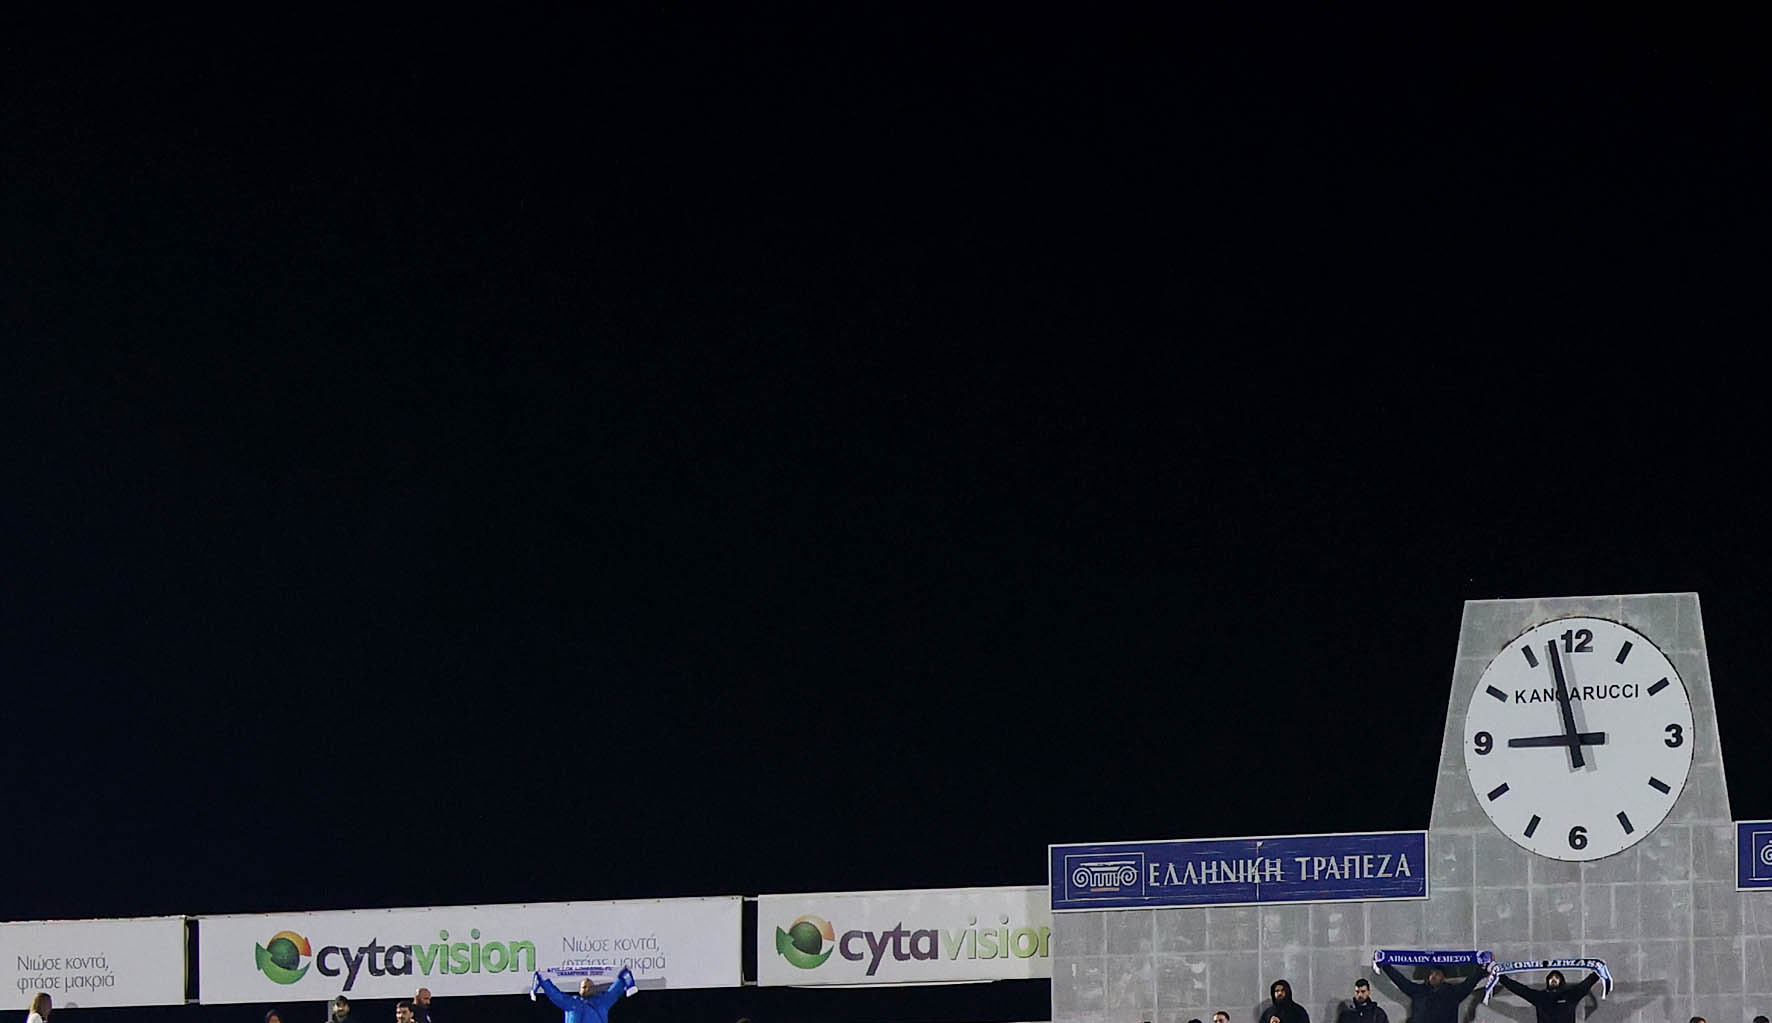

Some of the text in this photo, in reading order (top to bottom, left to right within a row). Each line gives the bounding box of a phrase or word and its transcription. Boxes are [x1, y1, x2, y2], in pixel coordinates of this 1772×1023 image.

[1561, 629, 1593, 653] 12
[1474, 731, 1494, 755] 9
[1664, 724, 1684, 748] 3
[1568, 826, 1588, 850] 6
[1149, 854, 1411, 887] ΕΛΛΗΝΙΚΗ ΤΡΑΠΕΖΑ
[562, 934, 660, 953] Νιώσε κοντά,
[17, 952, 109, 971] Νιώσε κοντά,
[316, 929, 536, 991] cytavision
[16, 971, 115, 994] φτάσε μακριά
